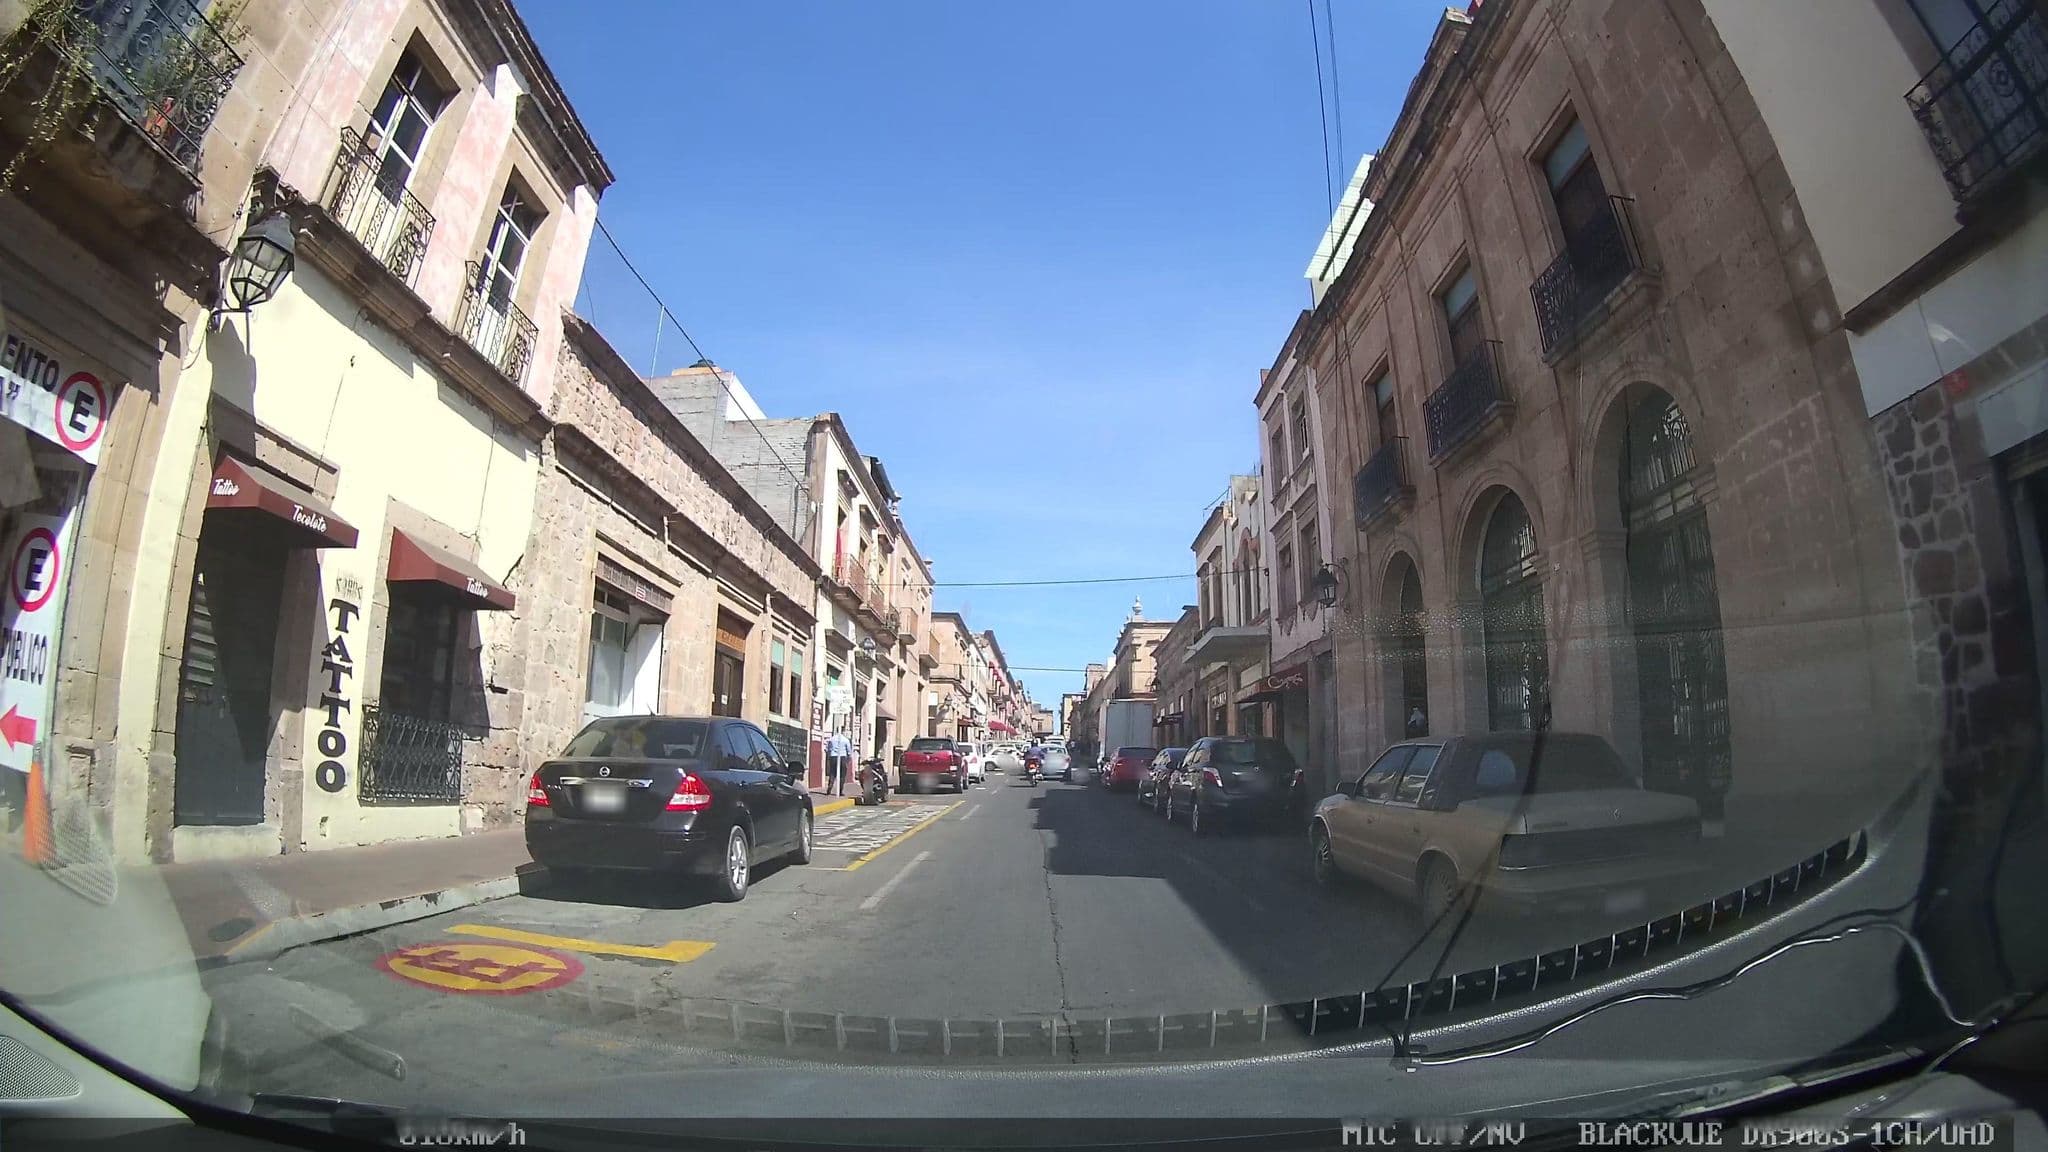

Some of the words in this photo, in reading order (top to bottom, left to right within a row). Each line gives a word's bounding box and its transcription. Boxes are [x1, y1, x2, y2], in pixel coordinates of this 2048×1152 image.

[69, 389, 95, 434] E
[212, 478, 241, 496] Tattoo
[291, 503, 328, 533] Tecolote
[24, 547, 49, 592] E
[465, 576, 489, 598] Tattoo
[315, 598, 360, 794] TATTOO
